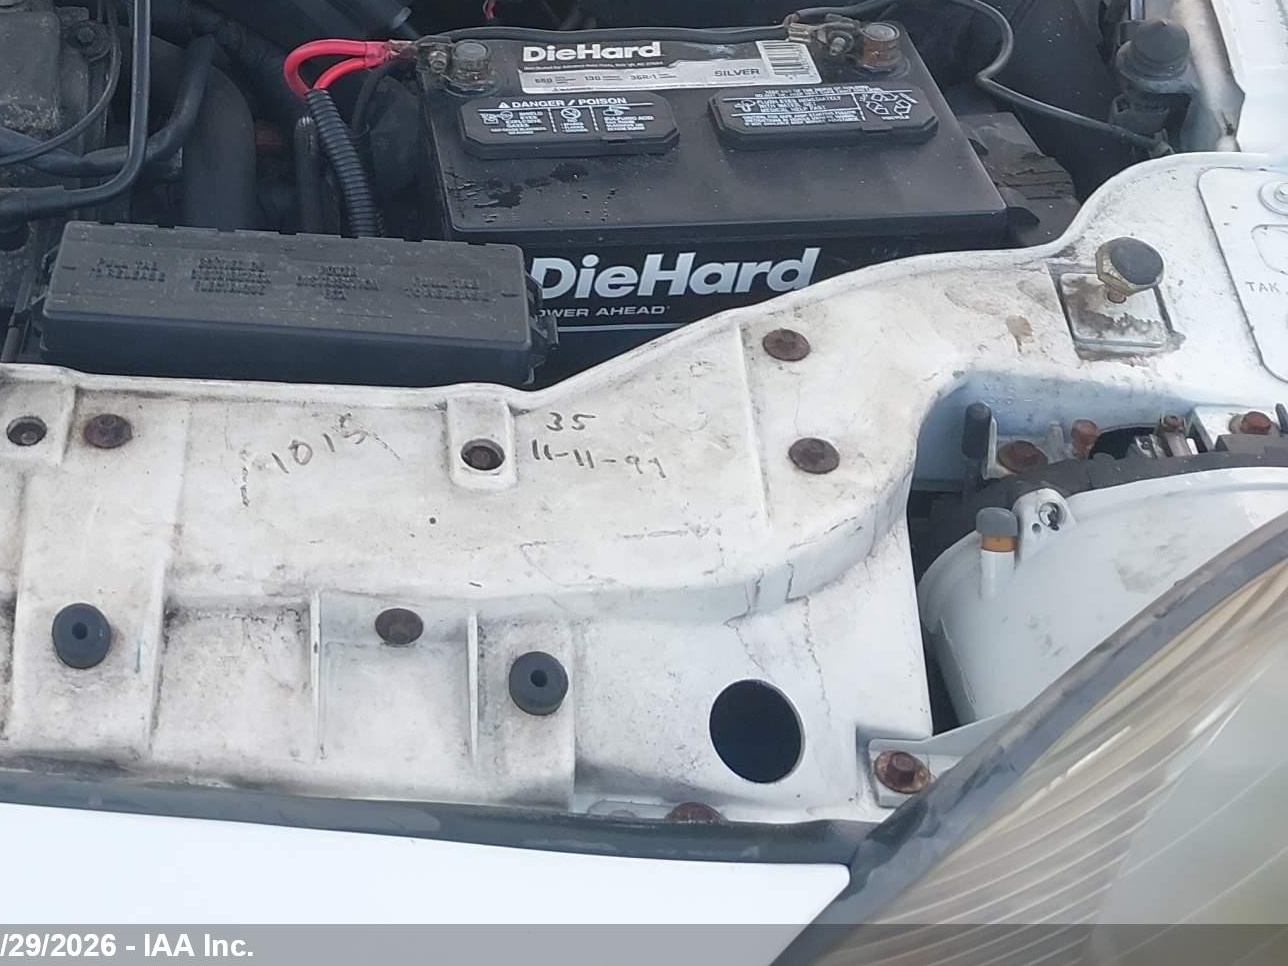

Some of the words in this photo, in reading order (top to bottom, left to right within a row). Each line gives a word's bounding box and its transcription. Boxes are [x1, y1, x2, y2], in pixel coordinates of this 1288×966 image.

[522, 42, 661, 62] DieHard
[714, 68, 761, 78] SILVER
[512, 99, 565, 108] DANGER
[578, 97, 627, 105] POISON
[531, 247, 821, 300] DieHard
[594, 306, 666, 317] AHEAD
[545, 411, 597, 432] 35
